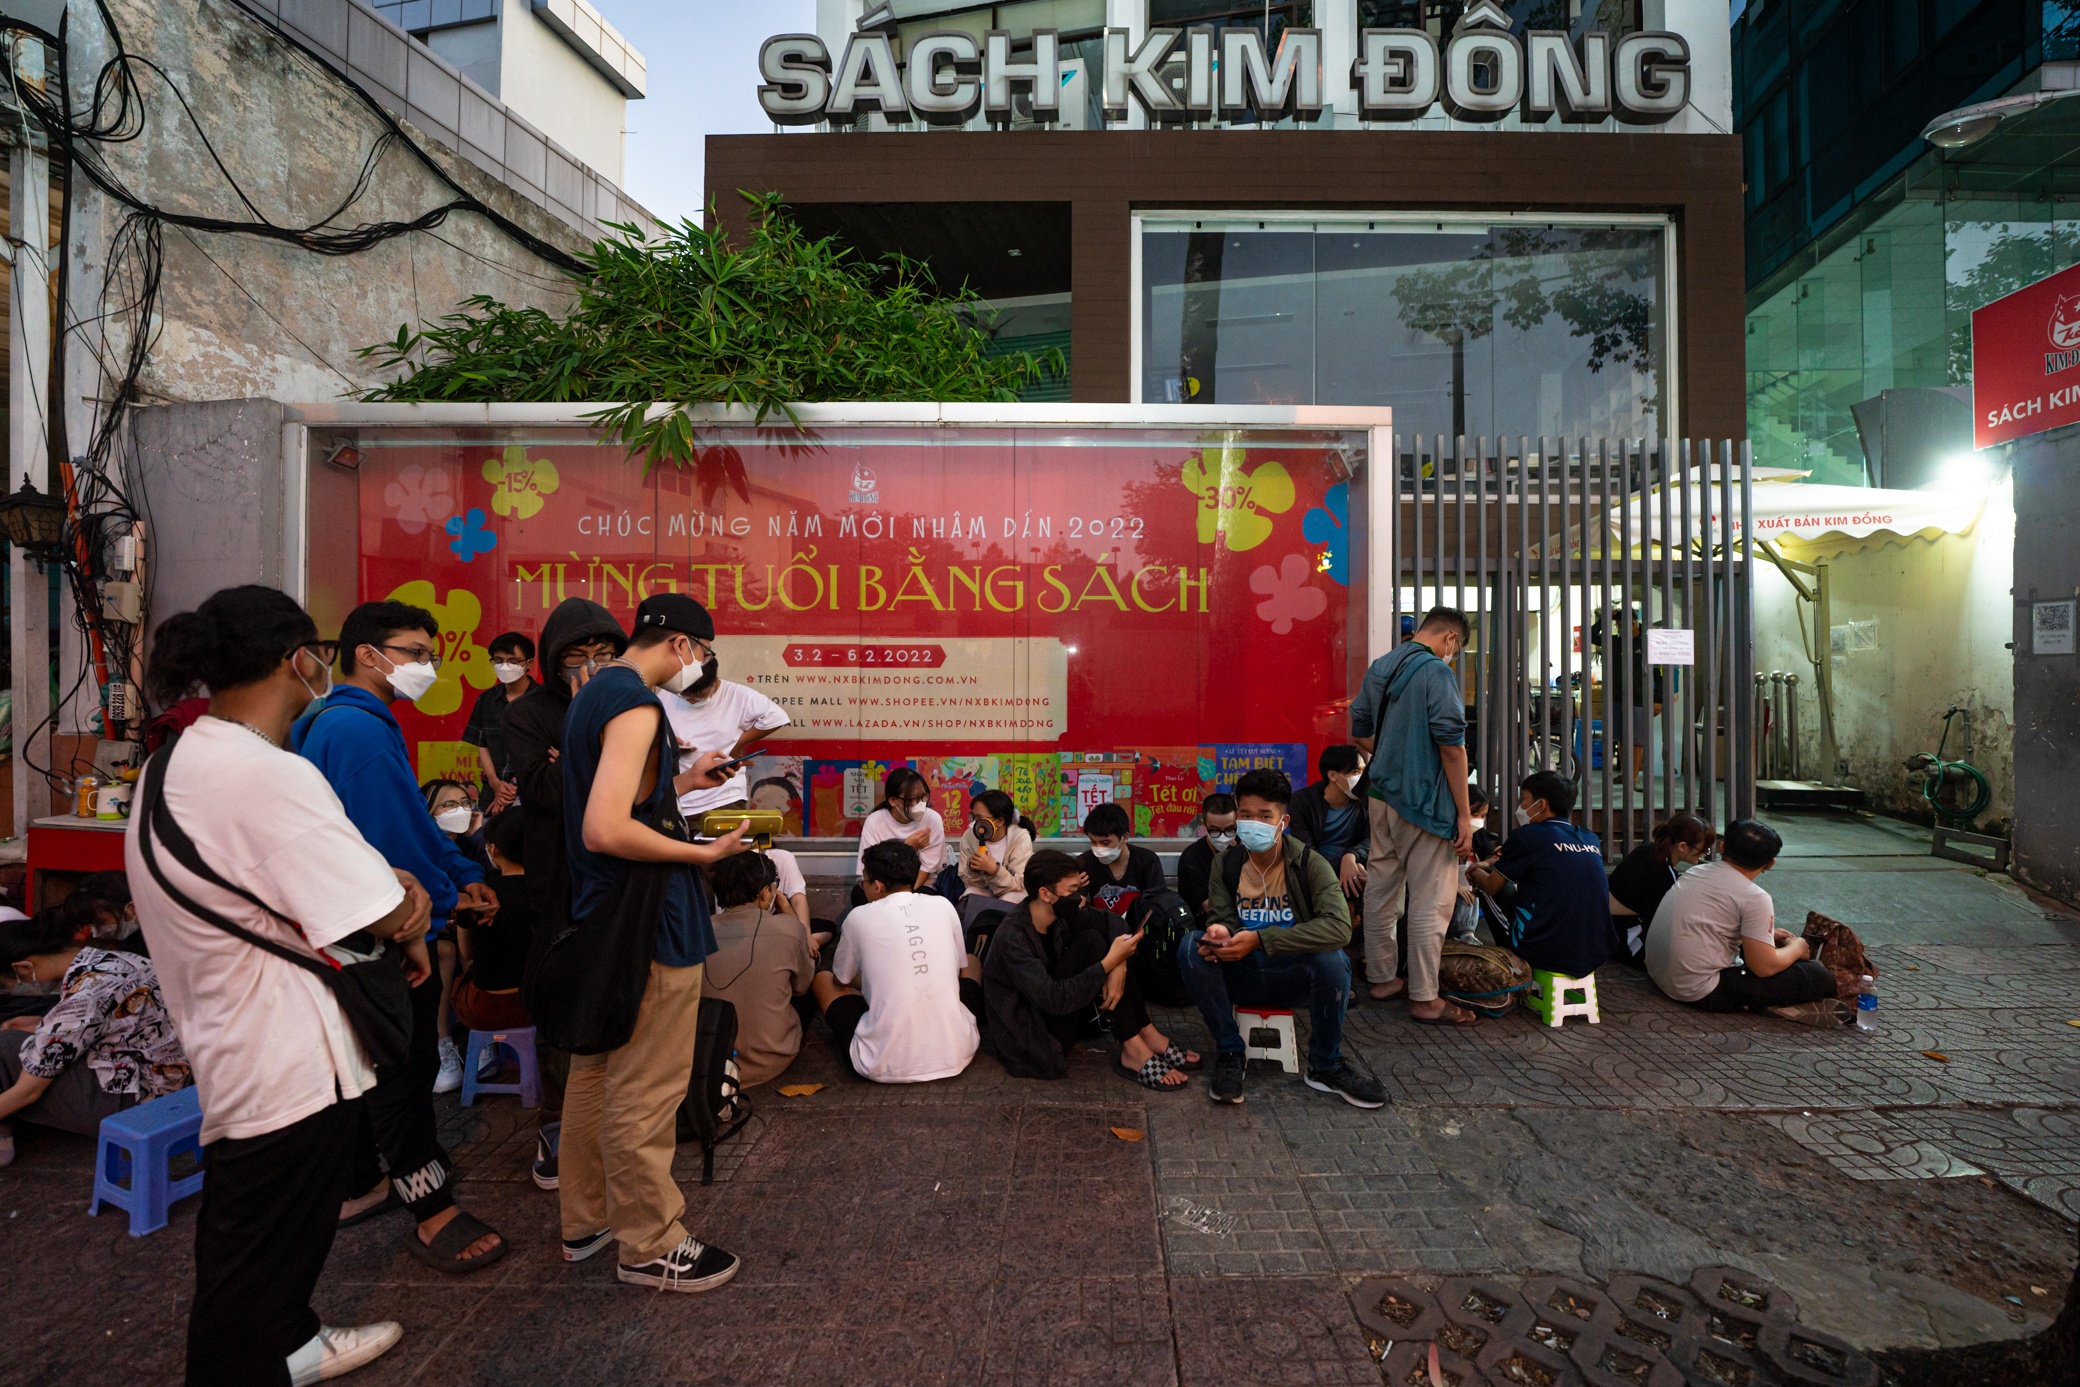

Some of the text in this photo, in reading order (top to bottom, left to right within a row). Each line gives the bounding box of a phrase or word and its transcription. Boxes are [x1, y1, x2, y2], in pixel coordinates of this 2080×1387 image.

[757, 1, 1060, 123] SÁCH
[1103, 27, 1323, 122] KIM
[2045, 353, 2068, 375] KIM
[1987, 396, 2042, 428] SÁCH
[498, 470, 537, 493] -15%
[1198, 485, 1256, 510] -30%
[578, 510, 651, 536] CHÚC
[668, 510, 751, 537] MỪNG
[768, 510, 823, 537] NĂM
[839, 510, 895, 539] MỚI
[913, 511, 987, 539] NHÂM
[1069, 517, 1144, 539] 2022
[1758, 515, 1790, 529] XUẤT
[1794, 514, 1820, 527] BẢN
[1825, 516, 1848, 526] KIM
[515, 544, 1210, 613] MỪNG TUỔI BẰNG SÁCH
[794, 649, 822, 662] 3.2
[848, 649, 933, 663] 6.2.2022
[758, 673, 978, 686] TRÊN WWW.NXBKIMDONG.COM.VN
[771, 696, 1050, 706] OPEE MALL WWW.SHOPEE.VN/NXBKIMDONG
[784, 718, 1054, 728] ALL WWW.LAZADA.VN/SHOP/NXBKIMDONG
[942, 789, 962, 808] 12
[1081, 783, 1107, 803] TẾT
[1149, 784, 1177, 802] Tết
[1150, 804, 1164, 816] Tết
[905, 924, 929, 976] AGCR
